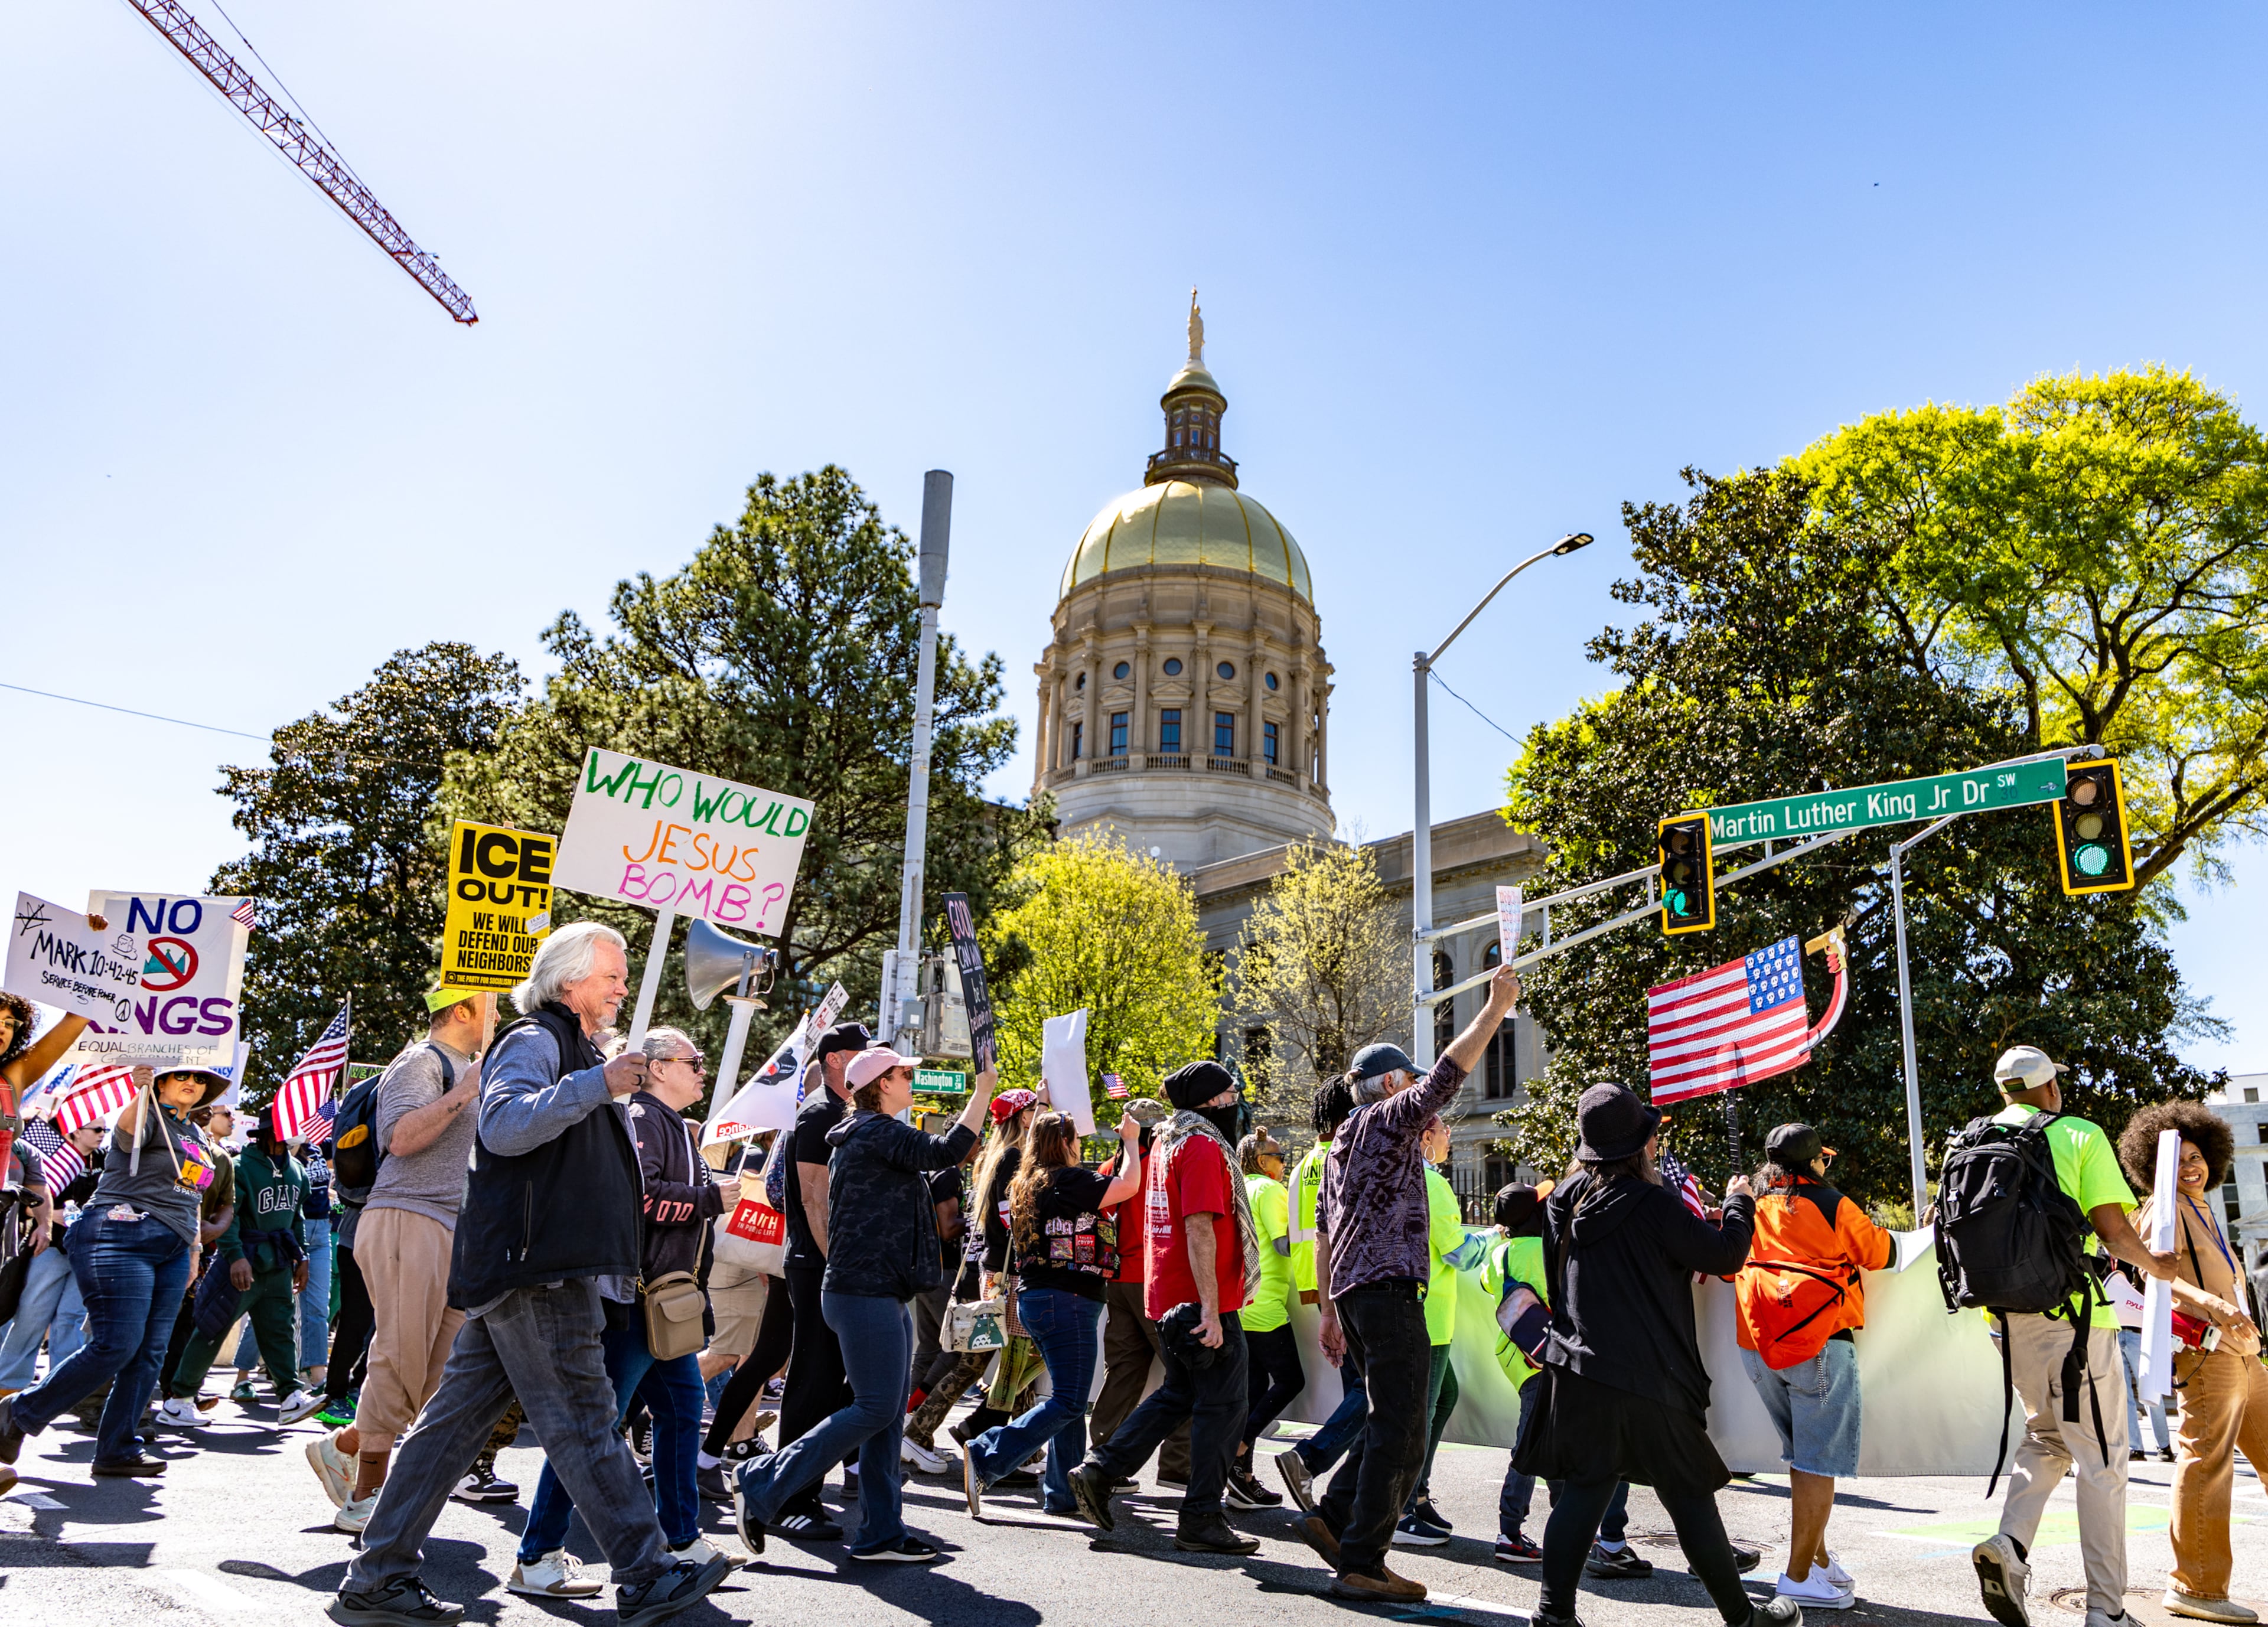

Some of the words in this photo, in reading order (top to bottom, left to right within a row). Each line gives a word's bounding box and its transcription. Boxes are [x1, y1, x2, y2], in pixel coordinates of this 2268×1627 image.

[586, 751, 683, 808] WHO
[693, 781, 809, 837] WOULD
[1710, 809, 1775, 839] Martin
[1784, 801, 1856, 829] Luther
[1867, 792, 1915, 820] King
[1927, 784, 1951, 810] Jr
[1962, 780, 1990, 805] Dr
[1997, 772, 2016, 787] SW
[459, 828, 551, 885] ICE
[623, 820, 759, 882] JESUS
[457, 879, 549, 909] OUT!
[618, 863, 784, 929] BOMB?
[126, 897, 203, 935] NO
[473, 912, 494, 931] WE
[498, 915, 527, 935] WILL
[948, 899, 975, 940] GOOD
[30, 930, 87, 974] MARK
[89, 950, 138, 986] 10:42-45
[458, 930, 509, 952] DEFEND
[513, 935, 538, 954] OUR
[457, 950, 535, 973] NEIGHBORS
[41, 970, 73, 989] SERVICE
[72, 981, 98, 998] BEFORE
[97, 988, 116, 1004] POWER
[465, 975, 480, 983] PARTY
[480, 976, 489, 984] FOR
[490, 977, 513, 986] SOCIALISM
[88, 996, 234, 1036] NGS
[78, 1041, 128, 1052] EQUAL
[128, 1043, 191, 1055] BRANCHES
[197, 1045, 218, 1055] OF
[914, 1070, 953, 1090] Washington
[740, 1208, 778, 1230] FAITH
[2126, 1299, 2144, 1310] PYLE
